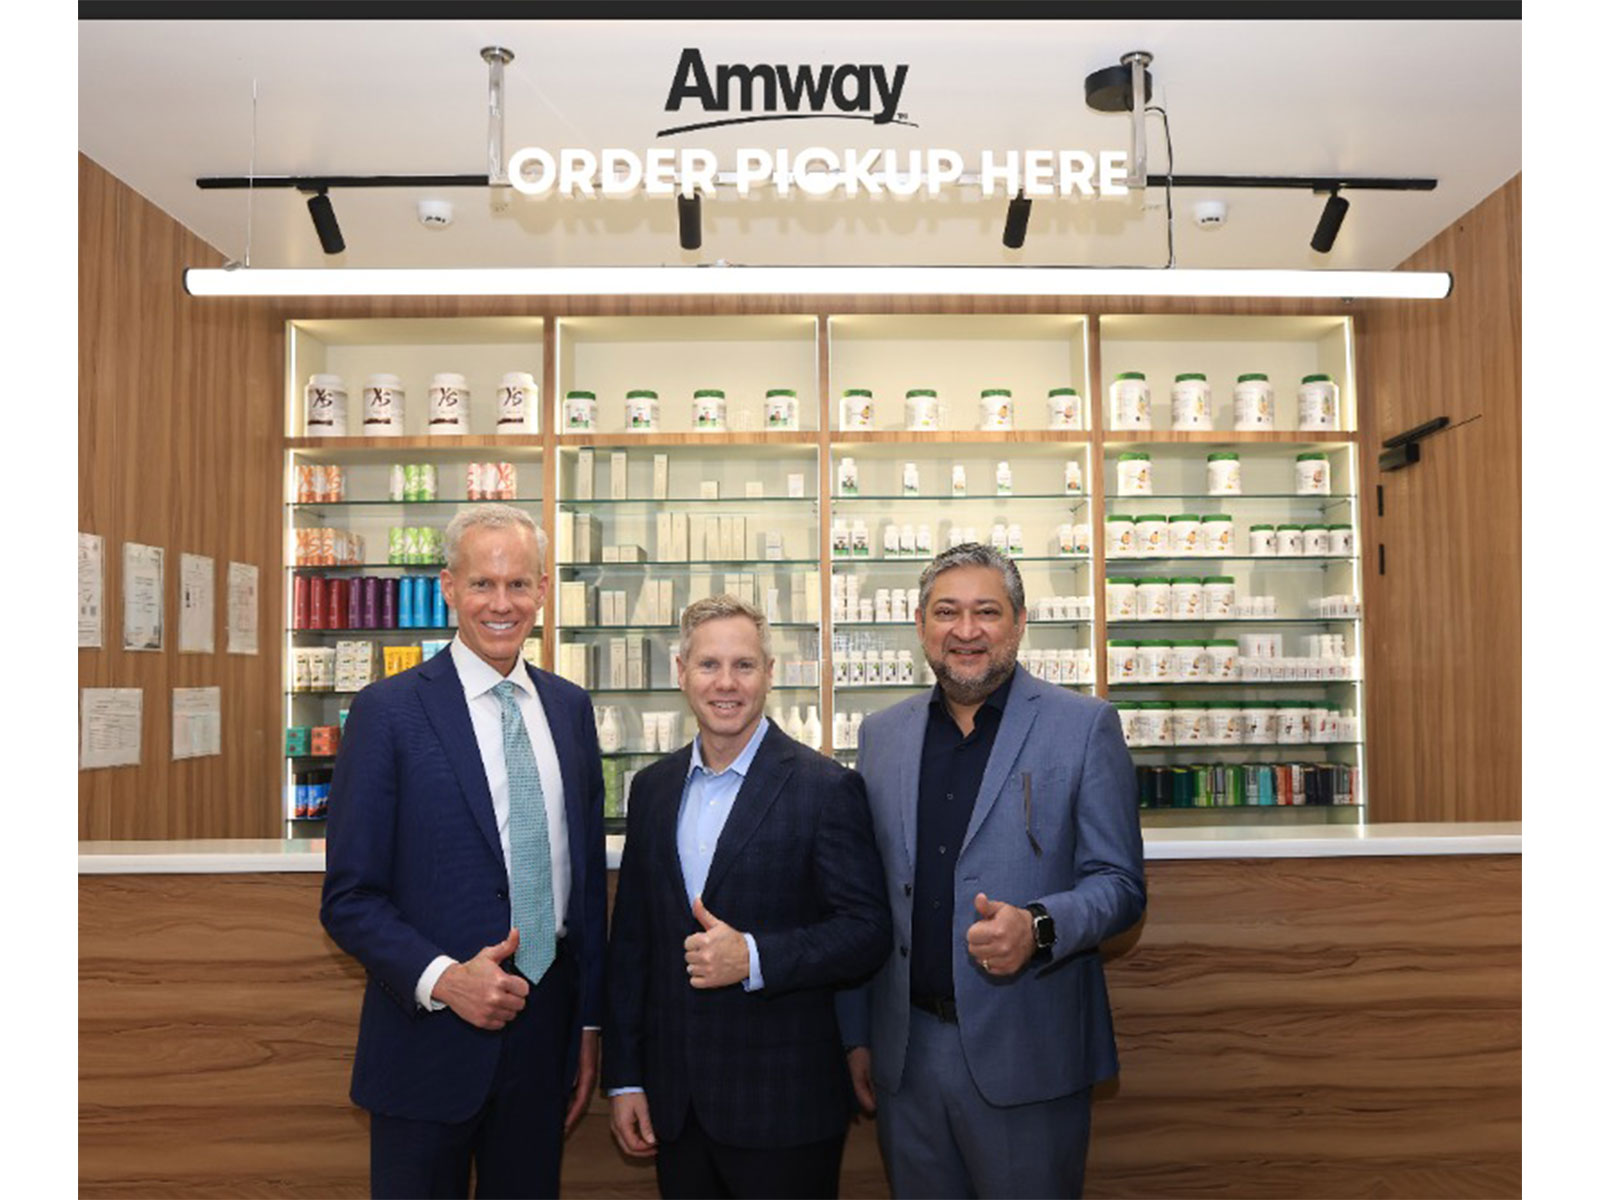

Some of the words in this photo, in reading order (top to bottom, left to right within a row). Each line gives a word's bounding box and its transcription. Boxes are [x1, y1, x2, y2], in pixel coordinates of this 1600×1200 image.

[664, 48, 909, 124] Amway
[508, 147, 718, 195] ORDER
[736, 147, 964, 195] PICKUP
[981, 150, 1129, 196] HERE
[312, 388, 333, 408] XS
